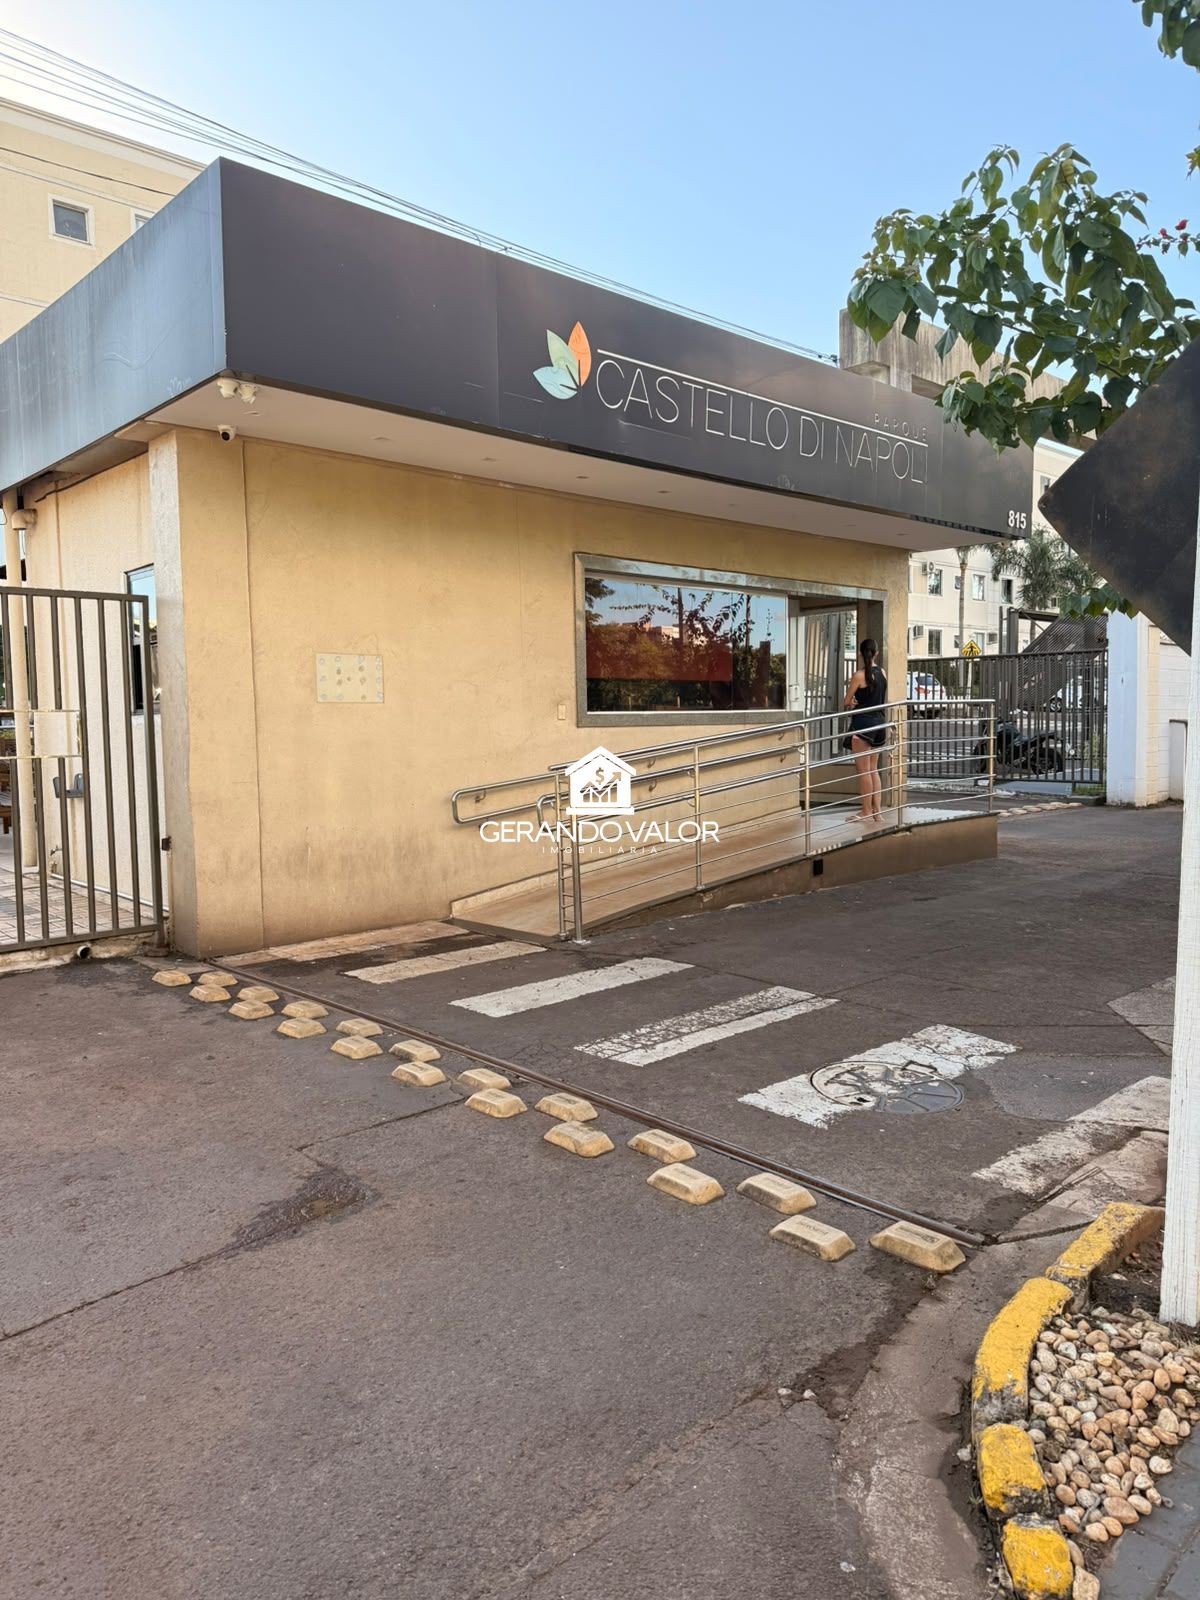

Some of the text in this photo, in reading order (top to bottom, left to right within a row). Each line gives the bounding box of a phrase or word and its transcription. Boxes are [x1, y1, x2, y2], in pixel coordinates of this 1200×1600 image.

[596, 359, 928, 484] CASTELLO DI NAPOLI
[1008, 509, 1027, 529] 815
